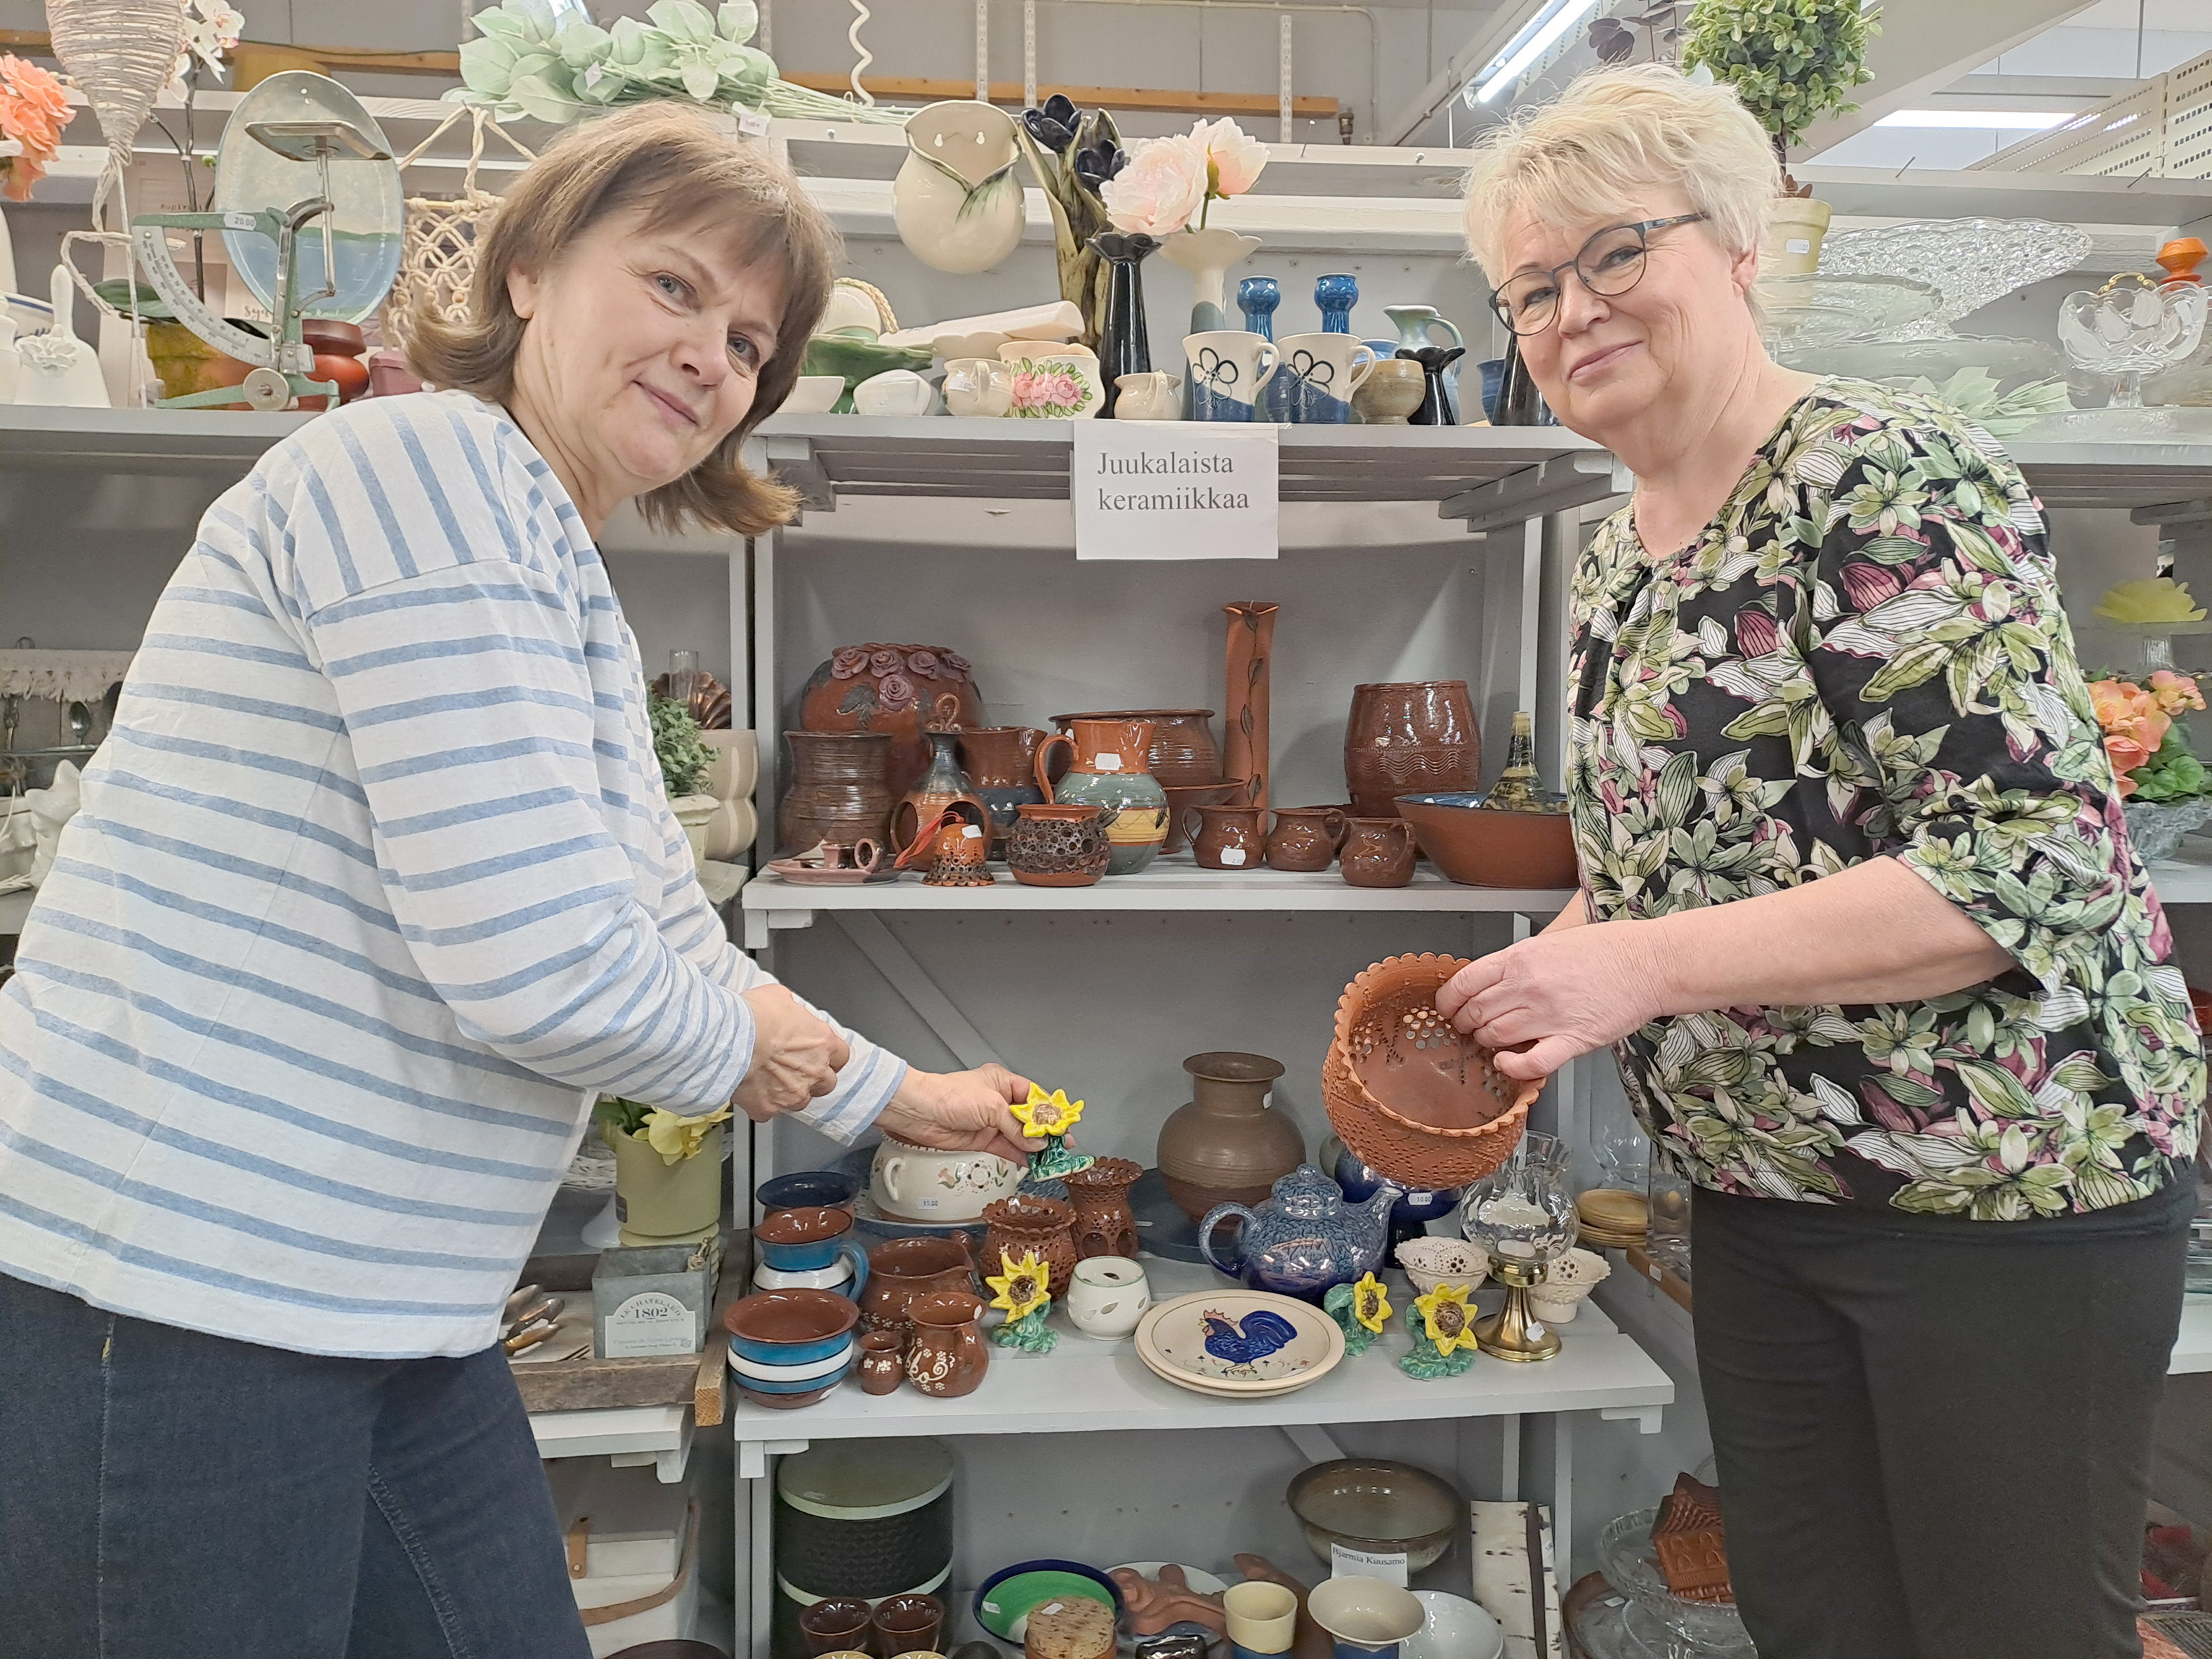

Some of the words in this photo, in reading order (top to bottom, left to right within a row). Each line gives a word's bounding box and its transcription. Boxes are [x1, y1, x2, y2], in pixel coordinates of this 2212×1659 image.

[1097, 450, 1235, 475] Juukalaista
[1098, 486, 1251, 511] keramiikkaa
[635, 1307, 668, 1318] 1802
[1332, 1547, 1364, 1563] Bjarmia
[1366, 1556, 1405, 1566] Kuusamo
